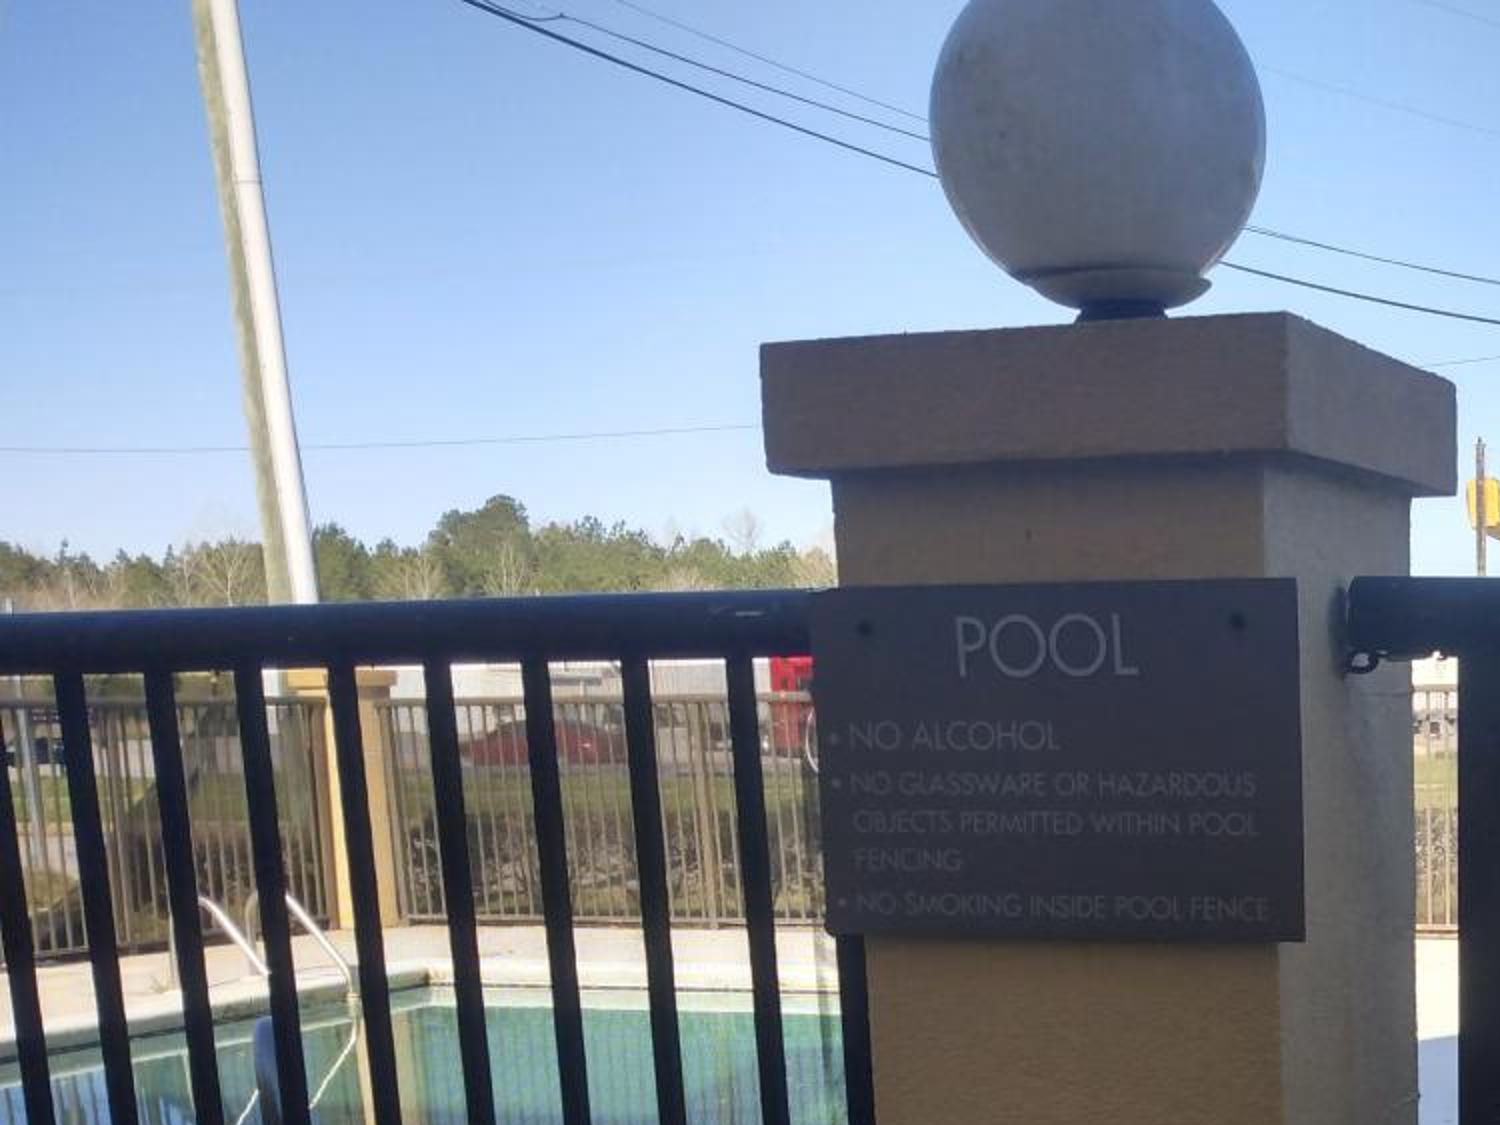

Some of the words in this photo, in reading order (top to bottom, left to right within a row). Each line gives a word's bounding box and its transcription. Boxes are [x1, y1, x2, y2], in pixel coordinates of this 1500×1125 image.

[955, 613, 1139, 678] POOL
[848, 720, 900, 751] NO
[911, 720, 1060, 751] ALCOHOL
[848, 772, 891, 797] NO
[898, 772, 1047, 798] GLASSWARE
[1056, 772, 1090, 798] OR
[1099, 772, 1257, 799] HAZARDOUS
[853, 809, 953, 834] OBJECTS
[960, 810, 1083, 836] PERMITTED
[1093, 811, 1181, 837] WITHIN
[1189, 812, 1260, 837] POOL
[853, 847, 963, 873] FENCING
[857, 893, 897, 917] NO
[904, 892, 1023, 918] SMOKING
[1030, 894, 1105, 920] INSIDE
[1114, 896, 1183, 921] POOL
[1190, 896, 1270, 922] FENCE
